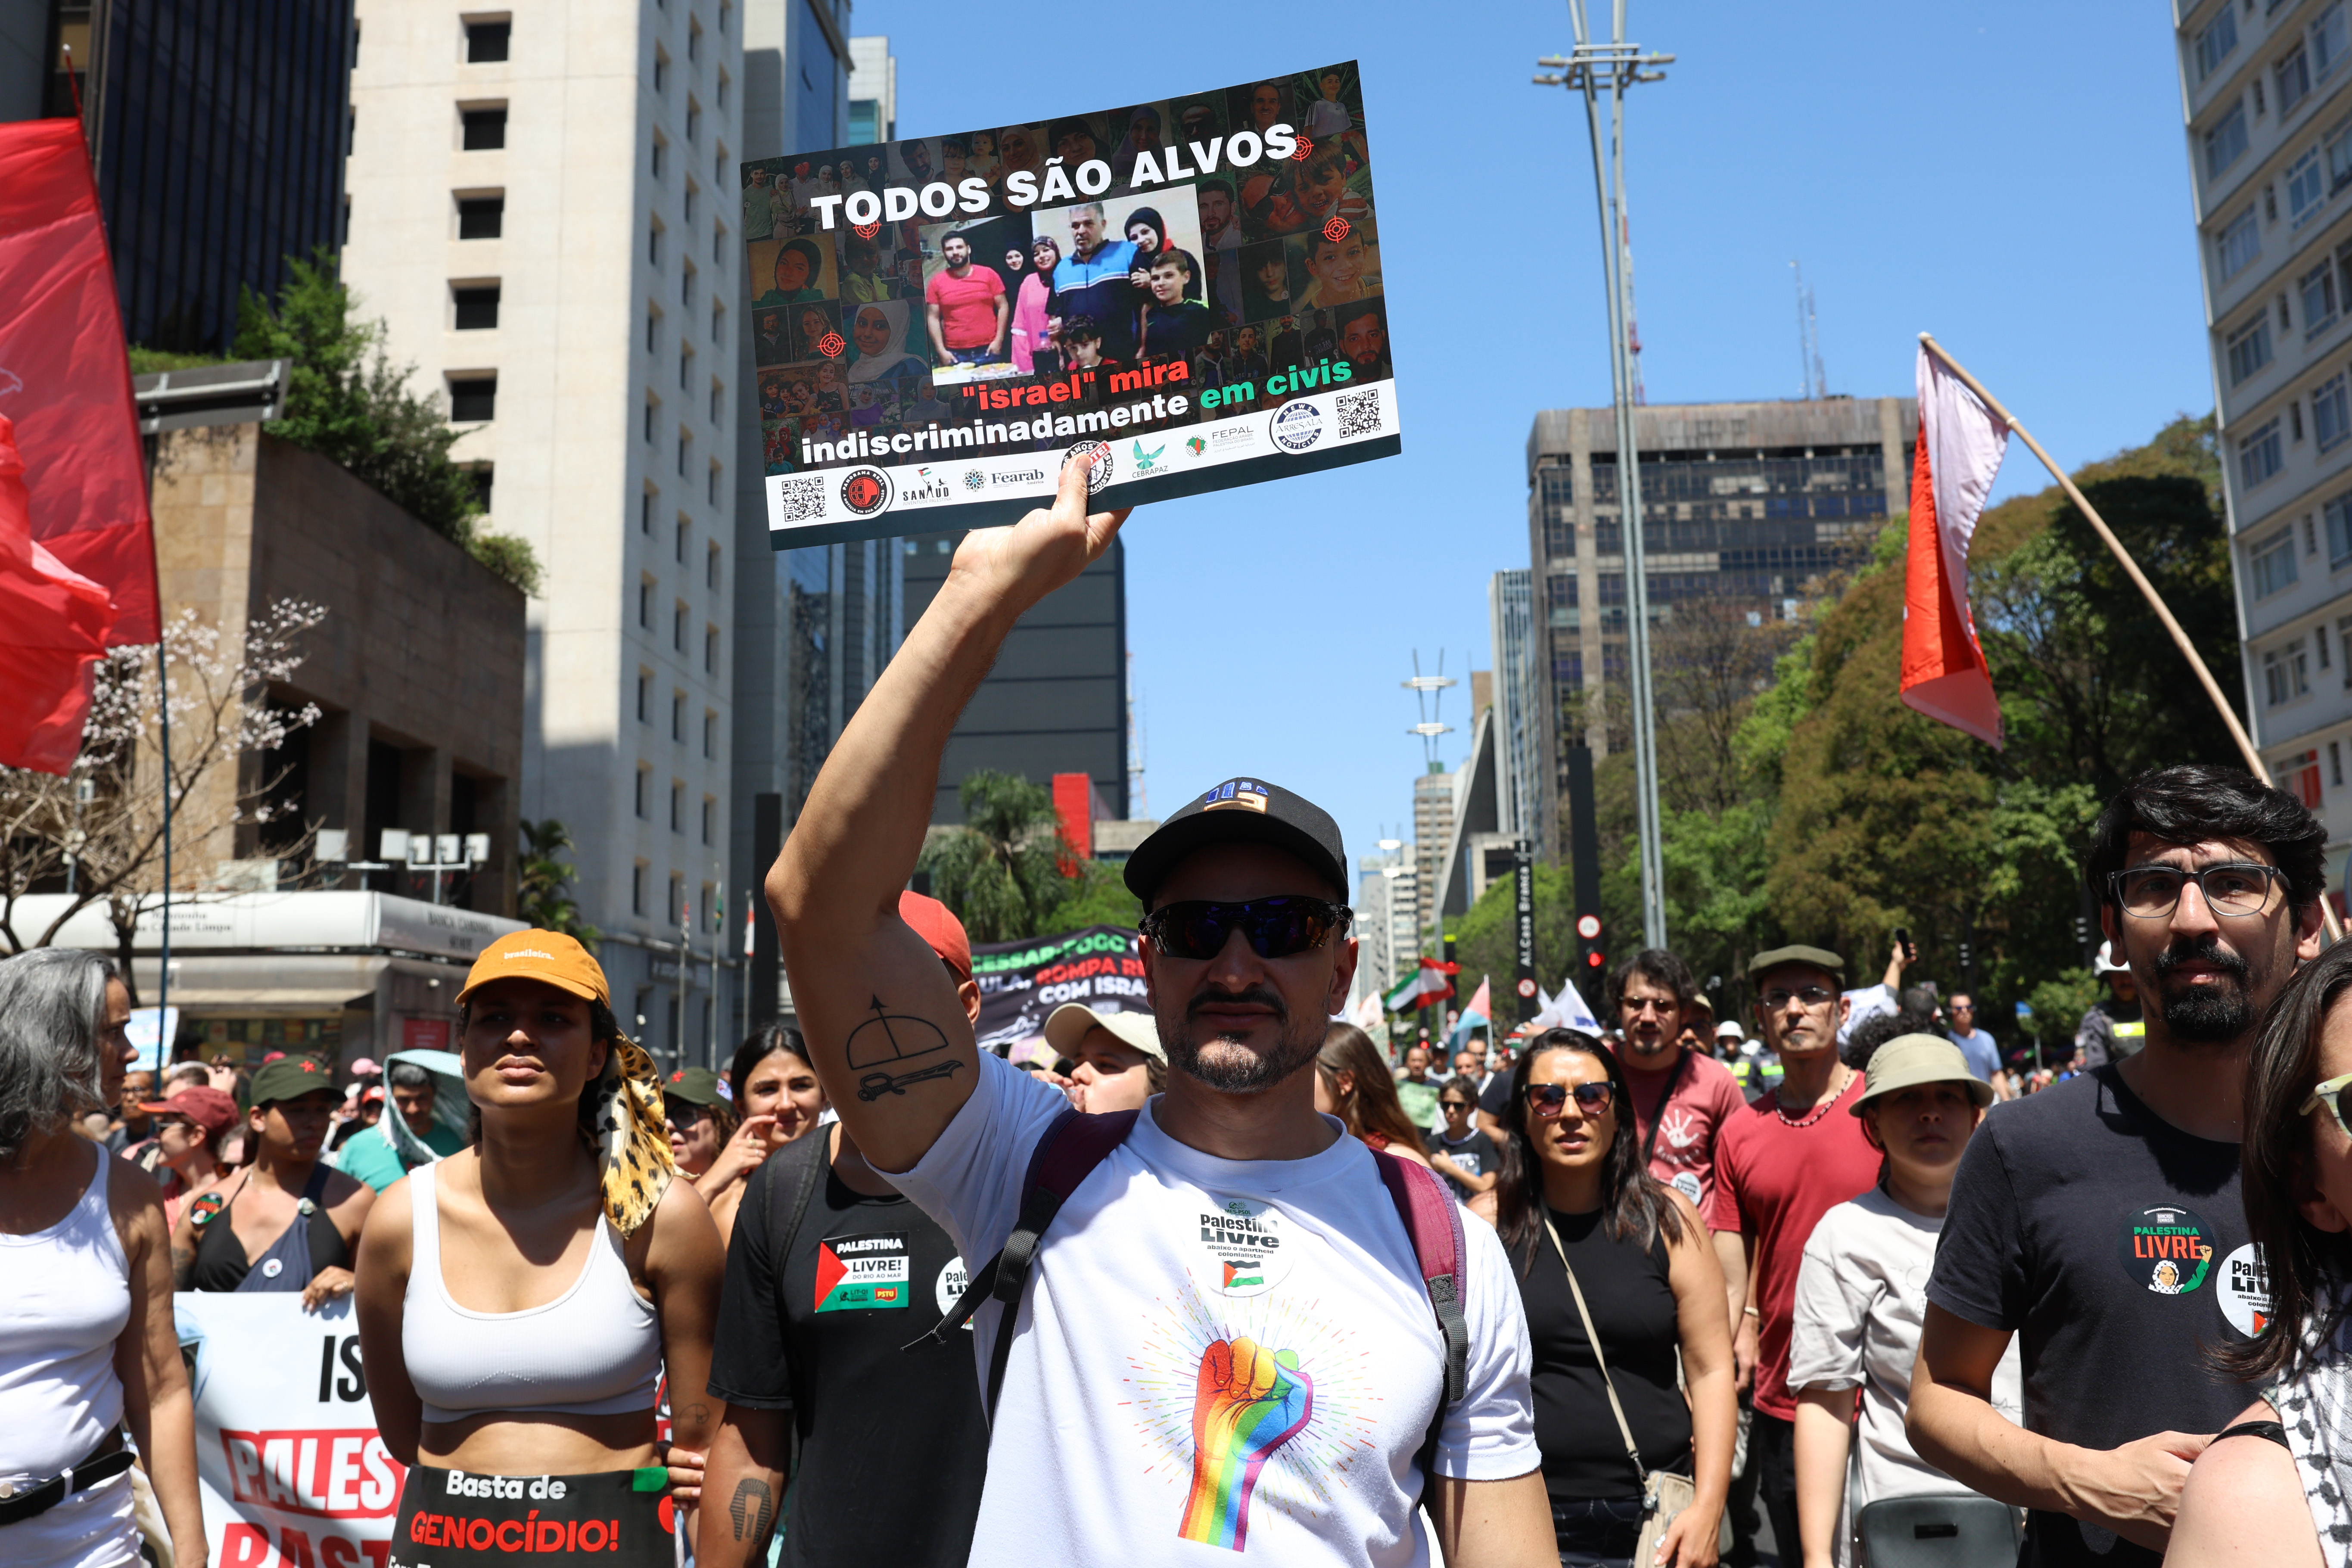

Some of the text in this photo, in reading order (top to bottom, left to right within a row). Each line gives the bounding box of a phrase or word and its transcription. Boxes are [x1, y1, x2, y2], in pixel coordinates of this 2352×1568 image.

[810, 124, 1297, 229] TODOS SÃO ALVOS
[963, 360, 1189, 410] "israel" mira
[802, 358, 1352, 464] indiscriminadamente em civis
[1283, 404, 1313, 416] NEWS
[1212, 426, 1254, 439] FEPAL
[1281, 431, 1319, 448] NOTÍCIAS
[843, 471, 884, 490] PANORAMA REAL
[991, 469, 1044, 484] Fearab
[1132, 465, 1168, 478] CEBRAPAZ
[844, 498, 856, 512] NOTÍCIA
[1036, 957, 1118, 985] ROMPA
[1039, 976, 1147, 1004] COM ISRA
[1201, 1228, 1279, 1248] Livre
[2134, 1227, 2200, 1235] PALESTINA
[837, 1238, 903, 1254] PALESTINA
[2134, 1236, 2203, 1259] LIVRE
[853, 1260, 902, 1272] LIVRE!
[946, 1271, 968, 1283] Pale
[319, 1335, 367, 1403] IS
[227, 1437, 396, 1510] PALES
[446, 1469, 566, 1500] Basta de
[411, 1510, 619, 1552] GENOCÍDIO!
[219, 1522, 390, 1568] BAST
